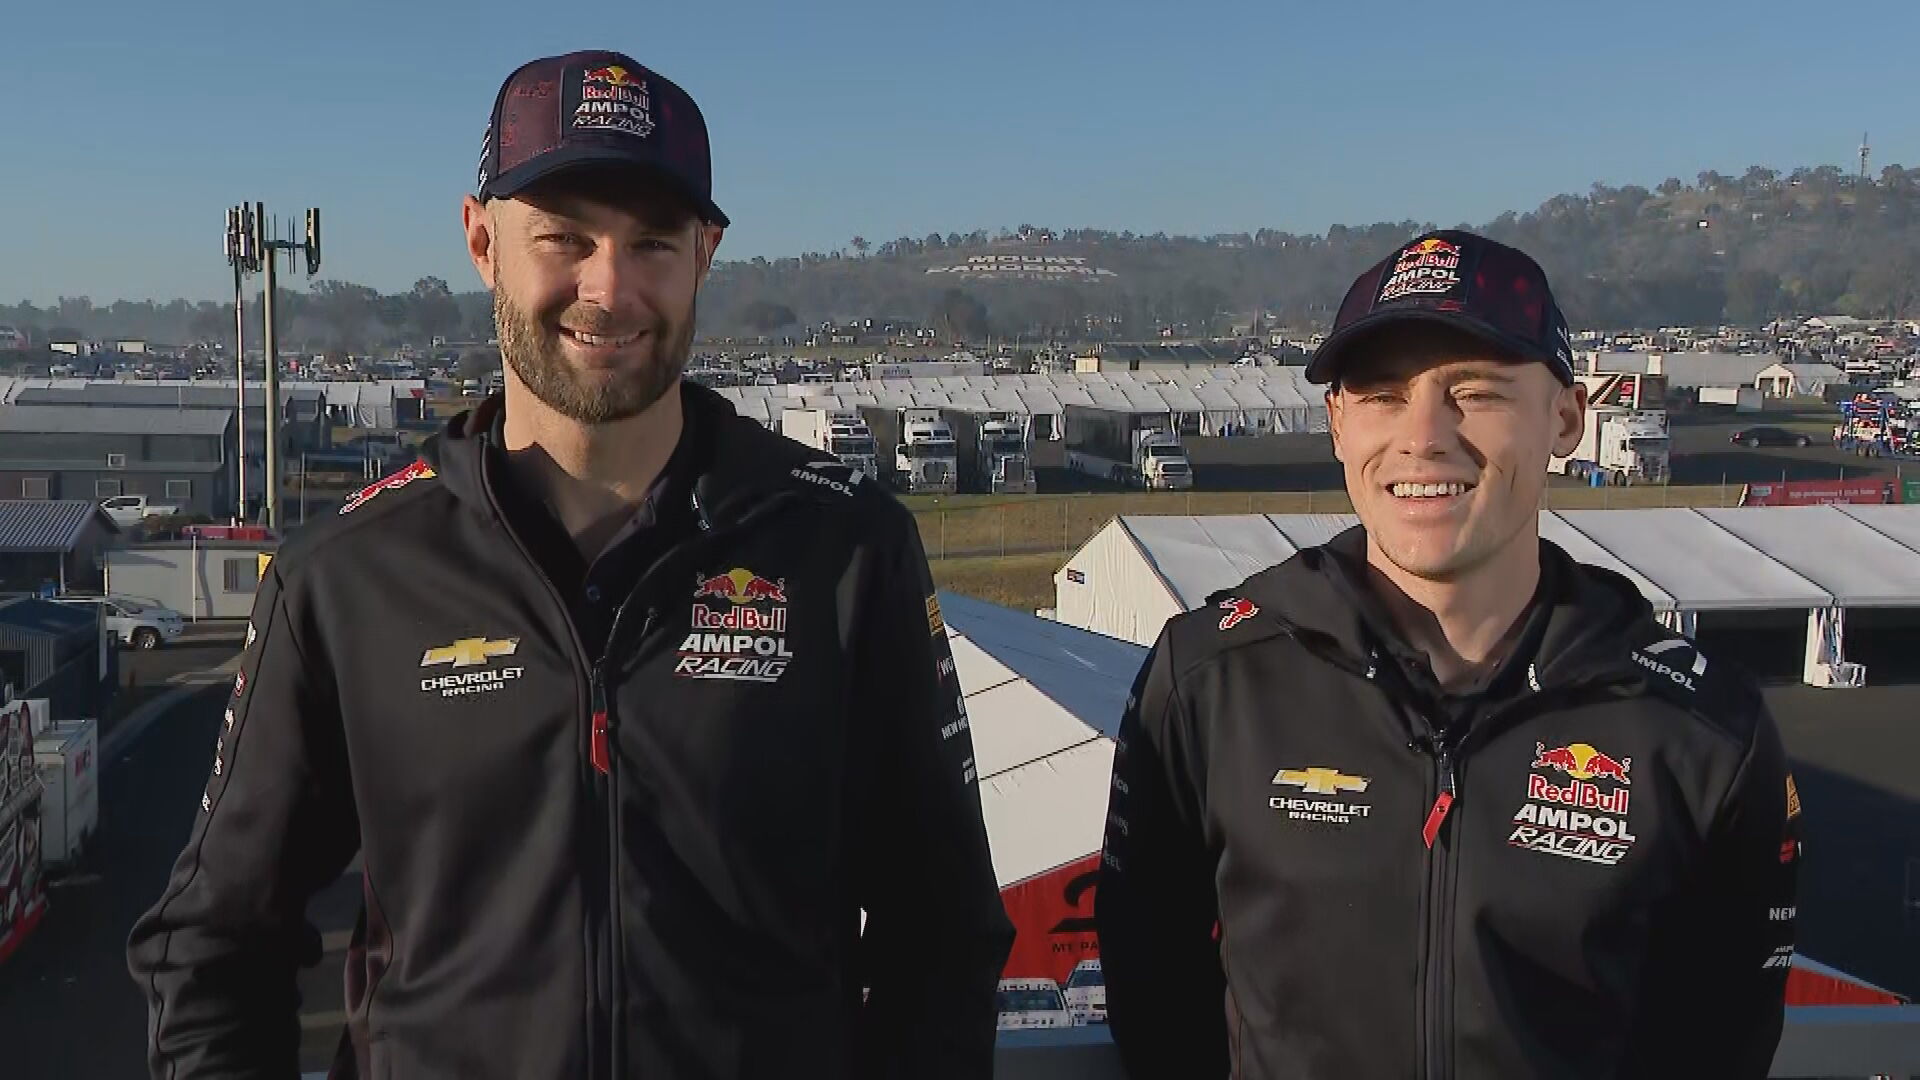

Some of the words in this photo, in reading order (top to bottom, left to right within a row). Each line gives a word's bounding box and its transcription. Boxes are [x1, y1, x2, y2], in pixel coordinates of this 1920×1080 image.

[583, 85, 617, 101] Red
[575, 102, 651, 122] AMPOL
[968, 255, 1088, 264] MOUNT
[1383, 267, 1461, 288] AMPOL
[790, 469, 853, 496] AMPOL
[692, 603, 739, 629] Red
[740, 607, 787, 632] Bull
[679, 633, 793, 657] AMPOL
[674, 657, 788, 677] RACING
[1631, 651, 1696, 692] AMPOL
[421, 667, 524, 691] CHEVROLET
[442, 682, 504, 697] RACING
[1528, 773, 1579, 806] Red
[1579, 783, 1630, 815] Bull
[1269, 797, 1372, 817] CHEVROLET
[1289, 811, 1349, 823] RACING
[1513, 803, 1636, 842] AMPOL
[1508, 825, 1629, 859] RACING
